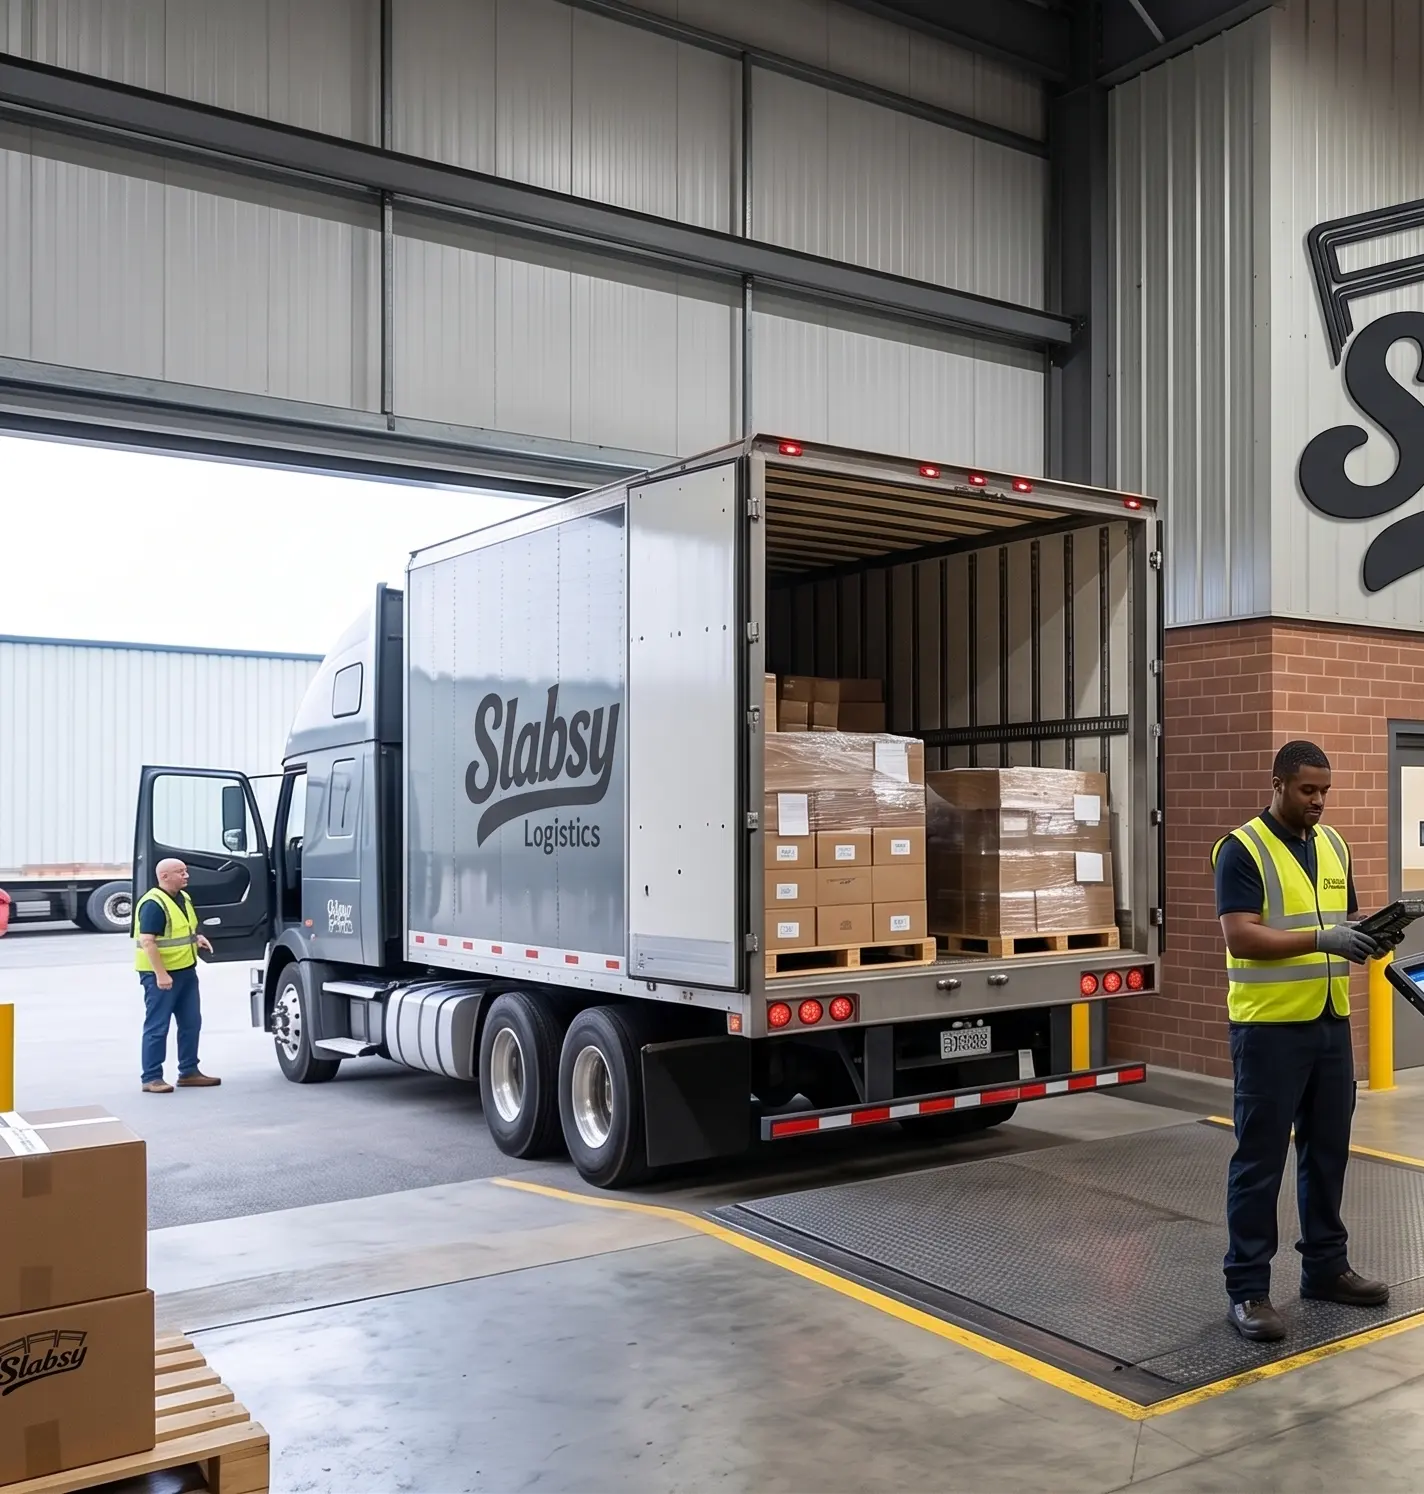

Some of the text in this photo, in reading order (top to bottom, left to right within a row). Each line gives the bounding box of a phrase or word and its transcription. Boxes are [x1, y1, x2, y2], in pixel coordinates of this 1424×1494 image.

[465, 683, 620, 848] Slabsy
[524, 817, 600, 855] Logistics
[0, 1346, 88, 1396] Slabsy
